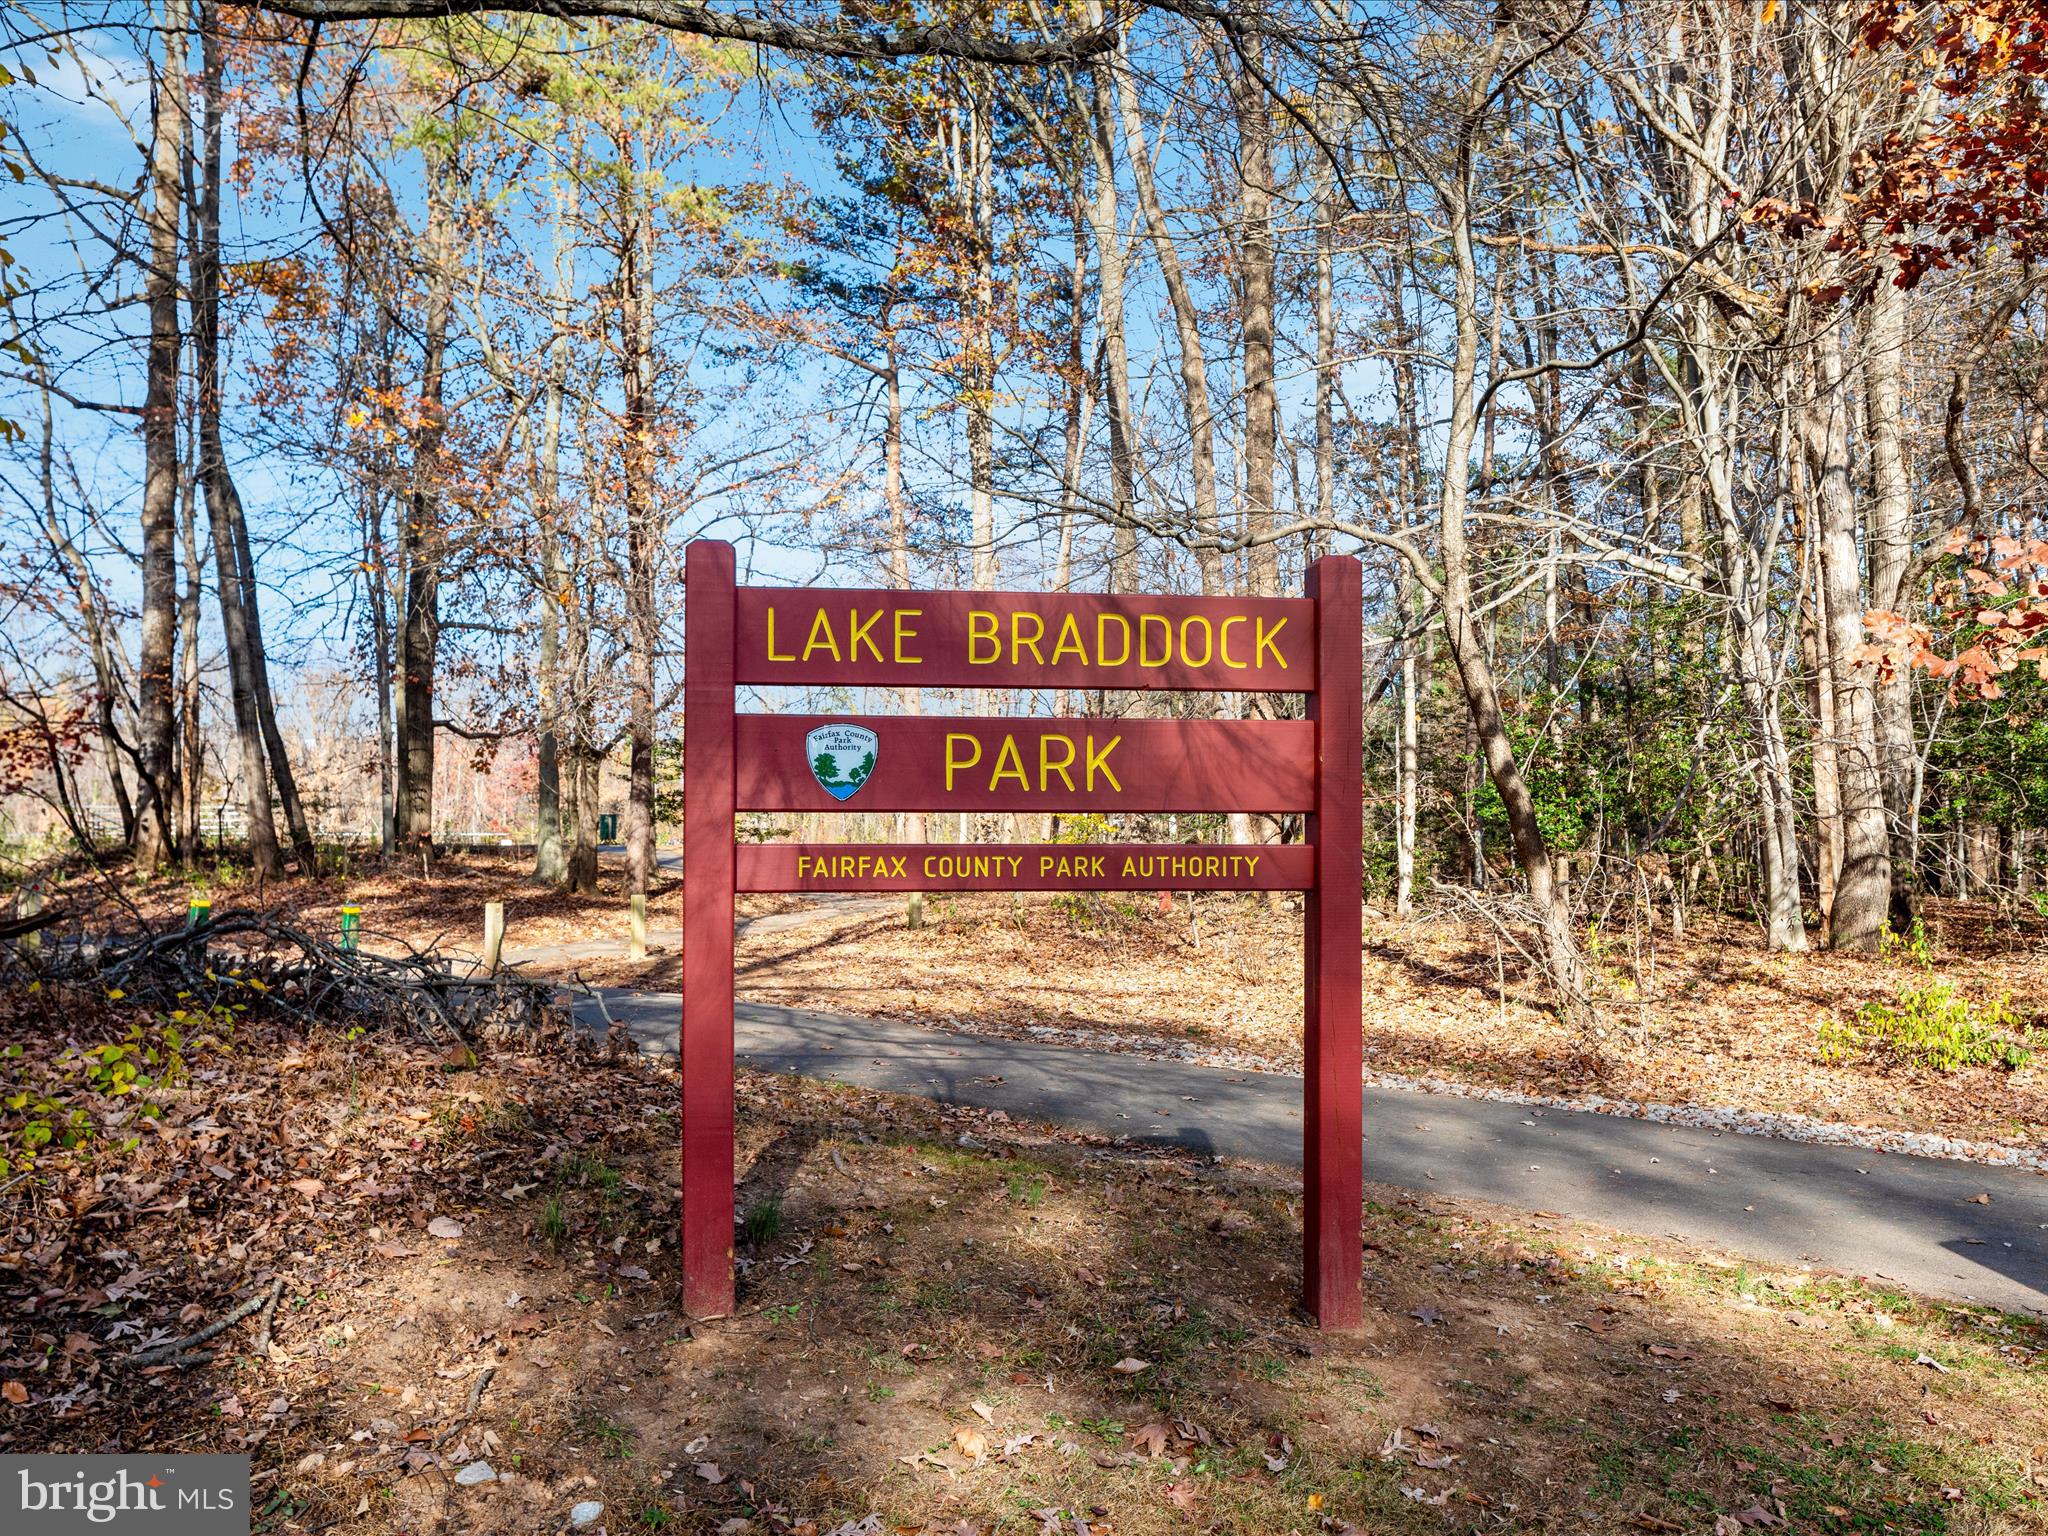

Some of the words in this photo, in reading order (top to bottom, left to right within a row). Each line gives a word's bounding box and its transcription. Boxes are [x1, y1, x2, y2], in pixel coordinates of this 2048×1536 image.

[768, 607, 922, 664] LAKE
[969, 610, 1288, 669] BRADDOCK
[813, 730, 841, 742] Fairfax
[844, 730, 873, 743] County
[824, 744, 862, 753] Authority
[945, 733, 1122, 792] PARK
[798, 855, 907, 878] FAIRFAX
[924, 855, 1023, 878] COUNTY
[1040, 856, 1105, 877] PARK
[1122, 855, 1260, 877] AUTHORITY
